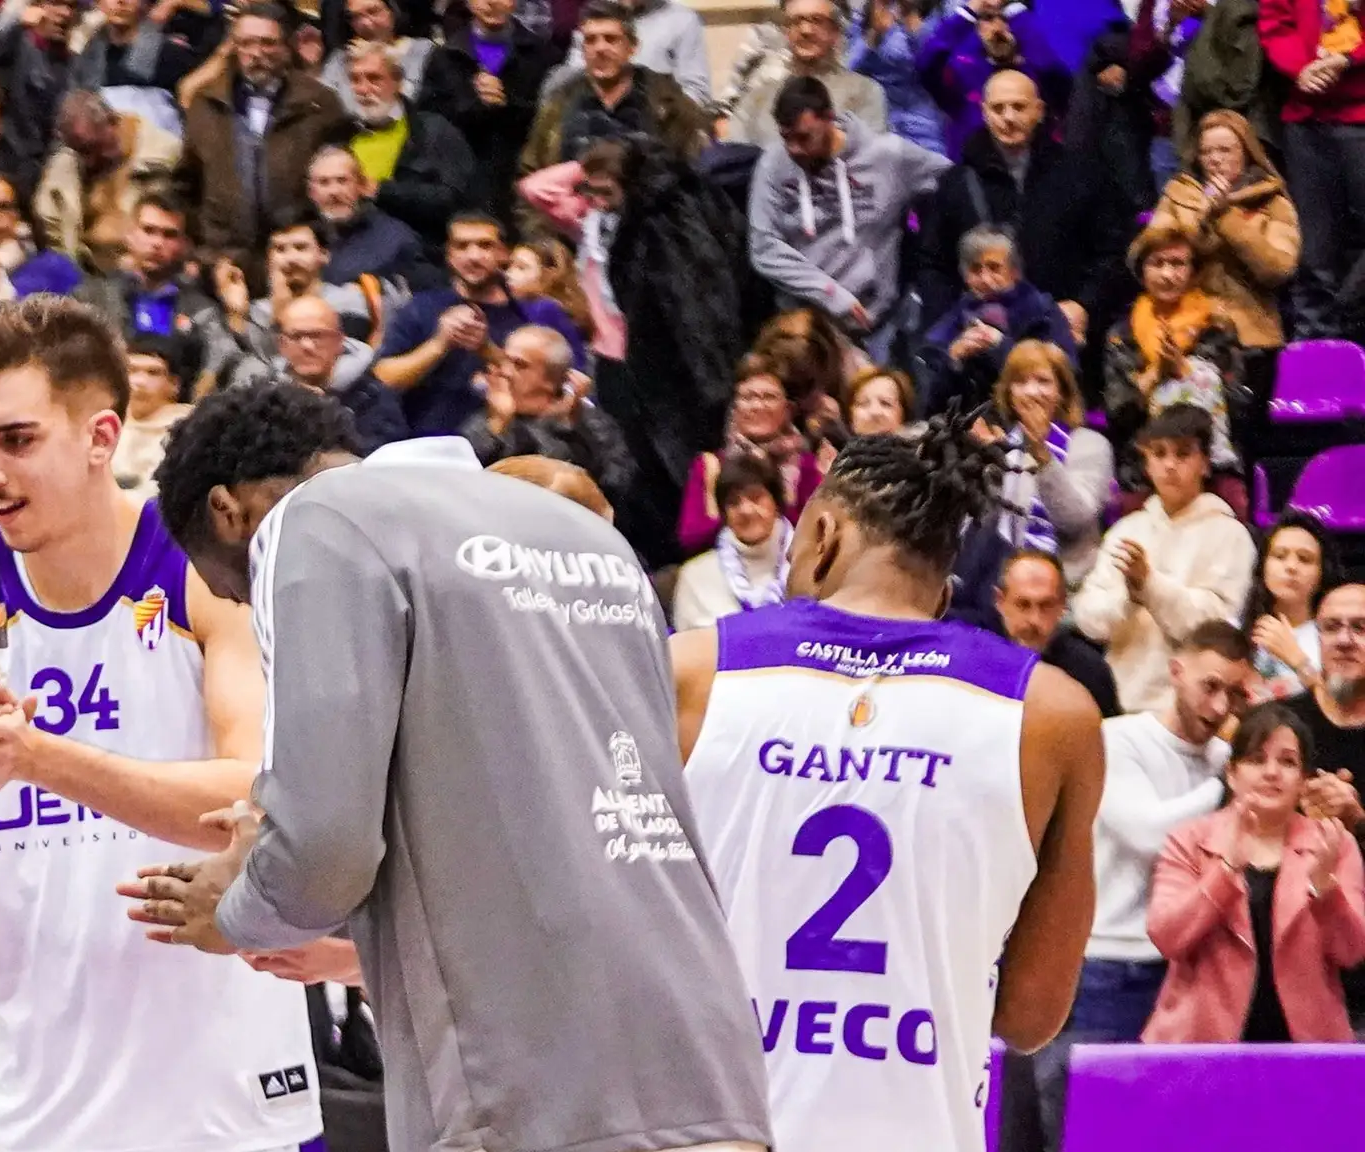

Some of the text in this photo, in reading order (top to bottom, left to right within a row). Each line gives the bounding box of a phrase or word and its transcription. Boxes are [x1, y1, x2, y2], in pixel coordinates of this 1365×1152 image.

[795, 641, 878, 667] CASTILLA
[30, 663, 120, 735] 34
[758, 737, 953, 788] GANTT
[785, 803, 894, 975] 2
